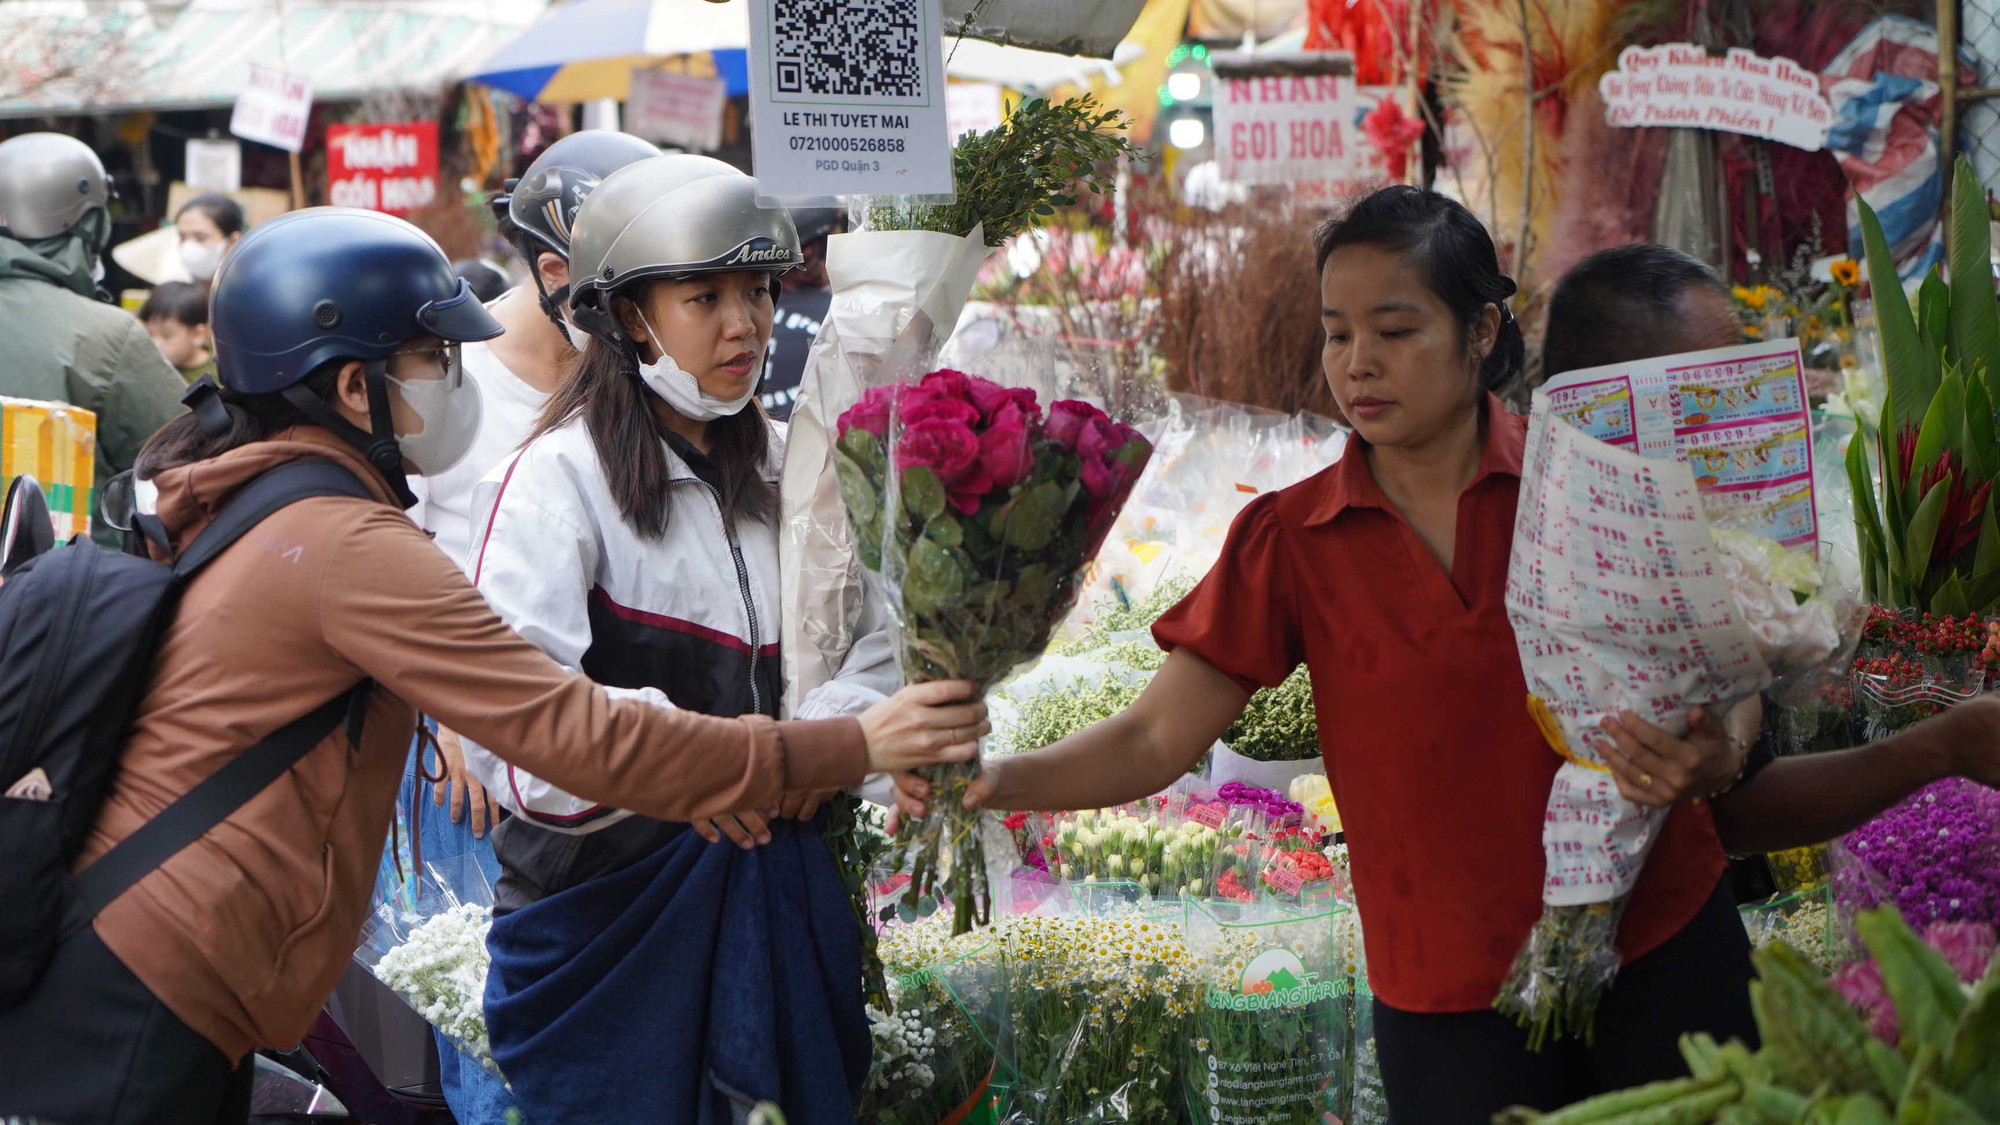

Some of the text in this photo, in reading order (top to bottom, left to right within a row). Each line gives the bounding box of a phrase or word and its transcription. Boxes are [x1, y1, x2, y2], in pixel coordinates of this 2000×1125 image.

[783, 112, 909, 129] LE THI TUYET MAI
[789, 136, 905, 152] 0721000526858
[1289, 119, 1344, 159] HOA
[815, 160, 880, 174] PGD Quận 3
[726, 244, 790, 265] Andes
[1267, 1112, 1291, 1122] Farm
